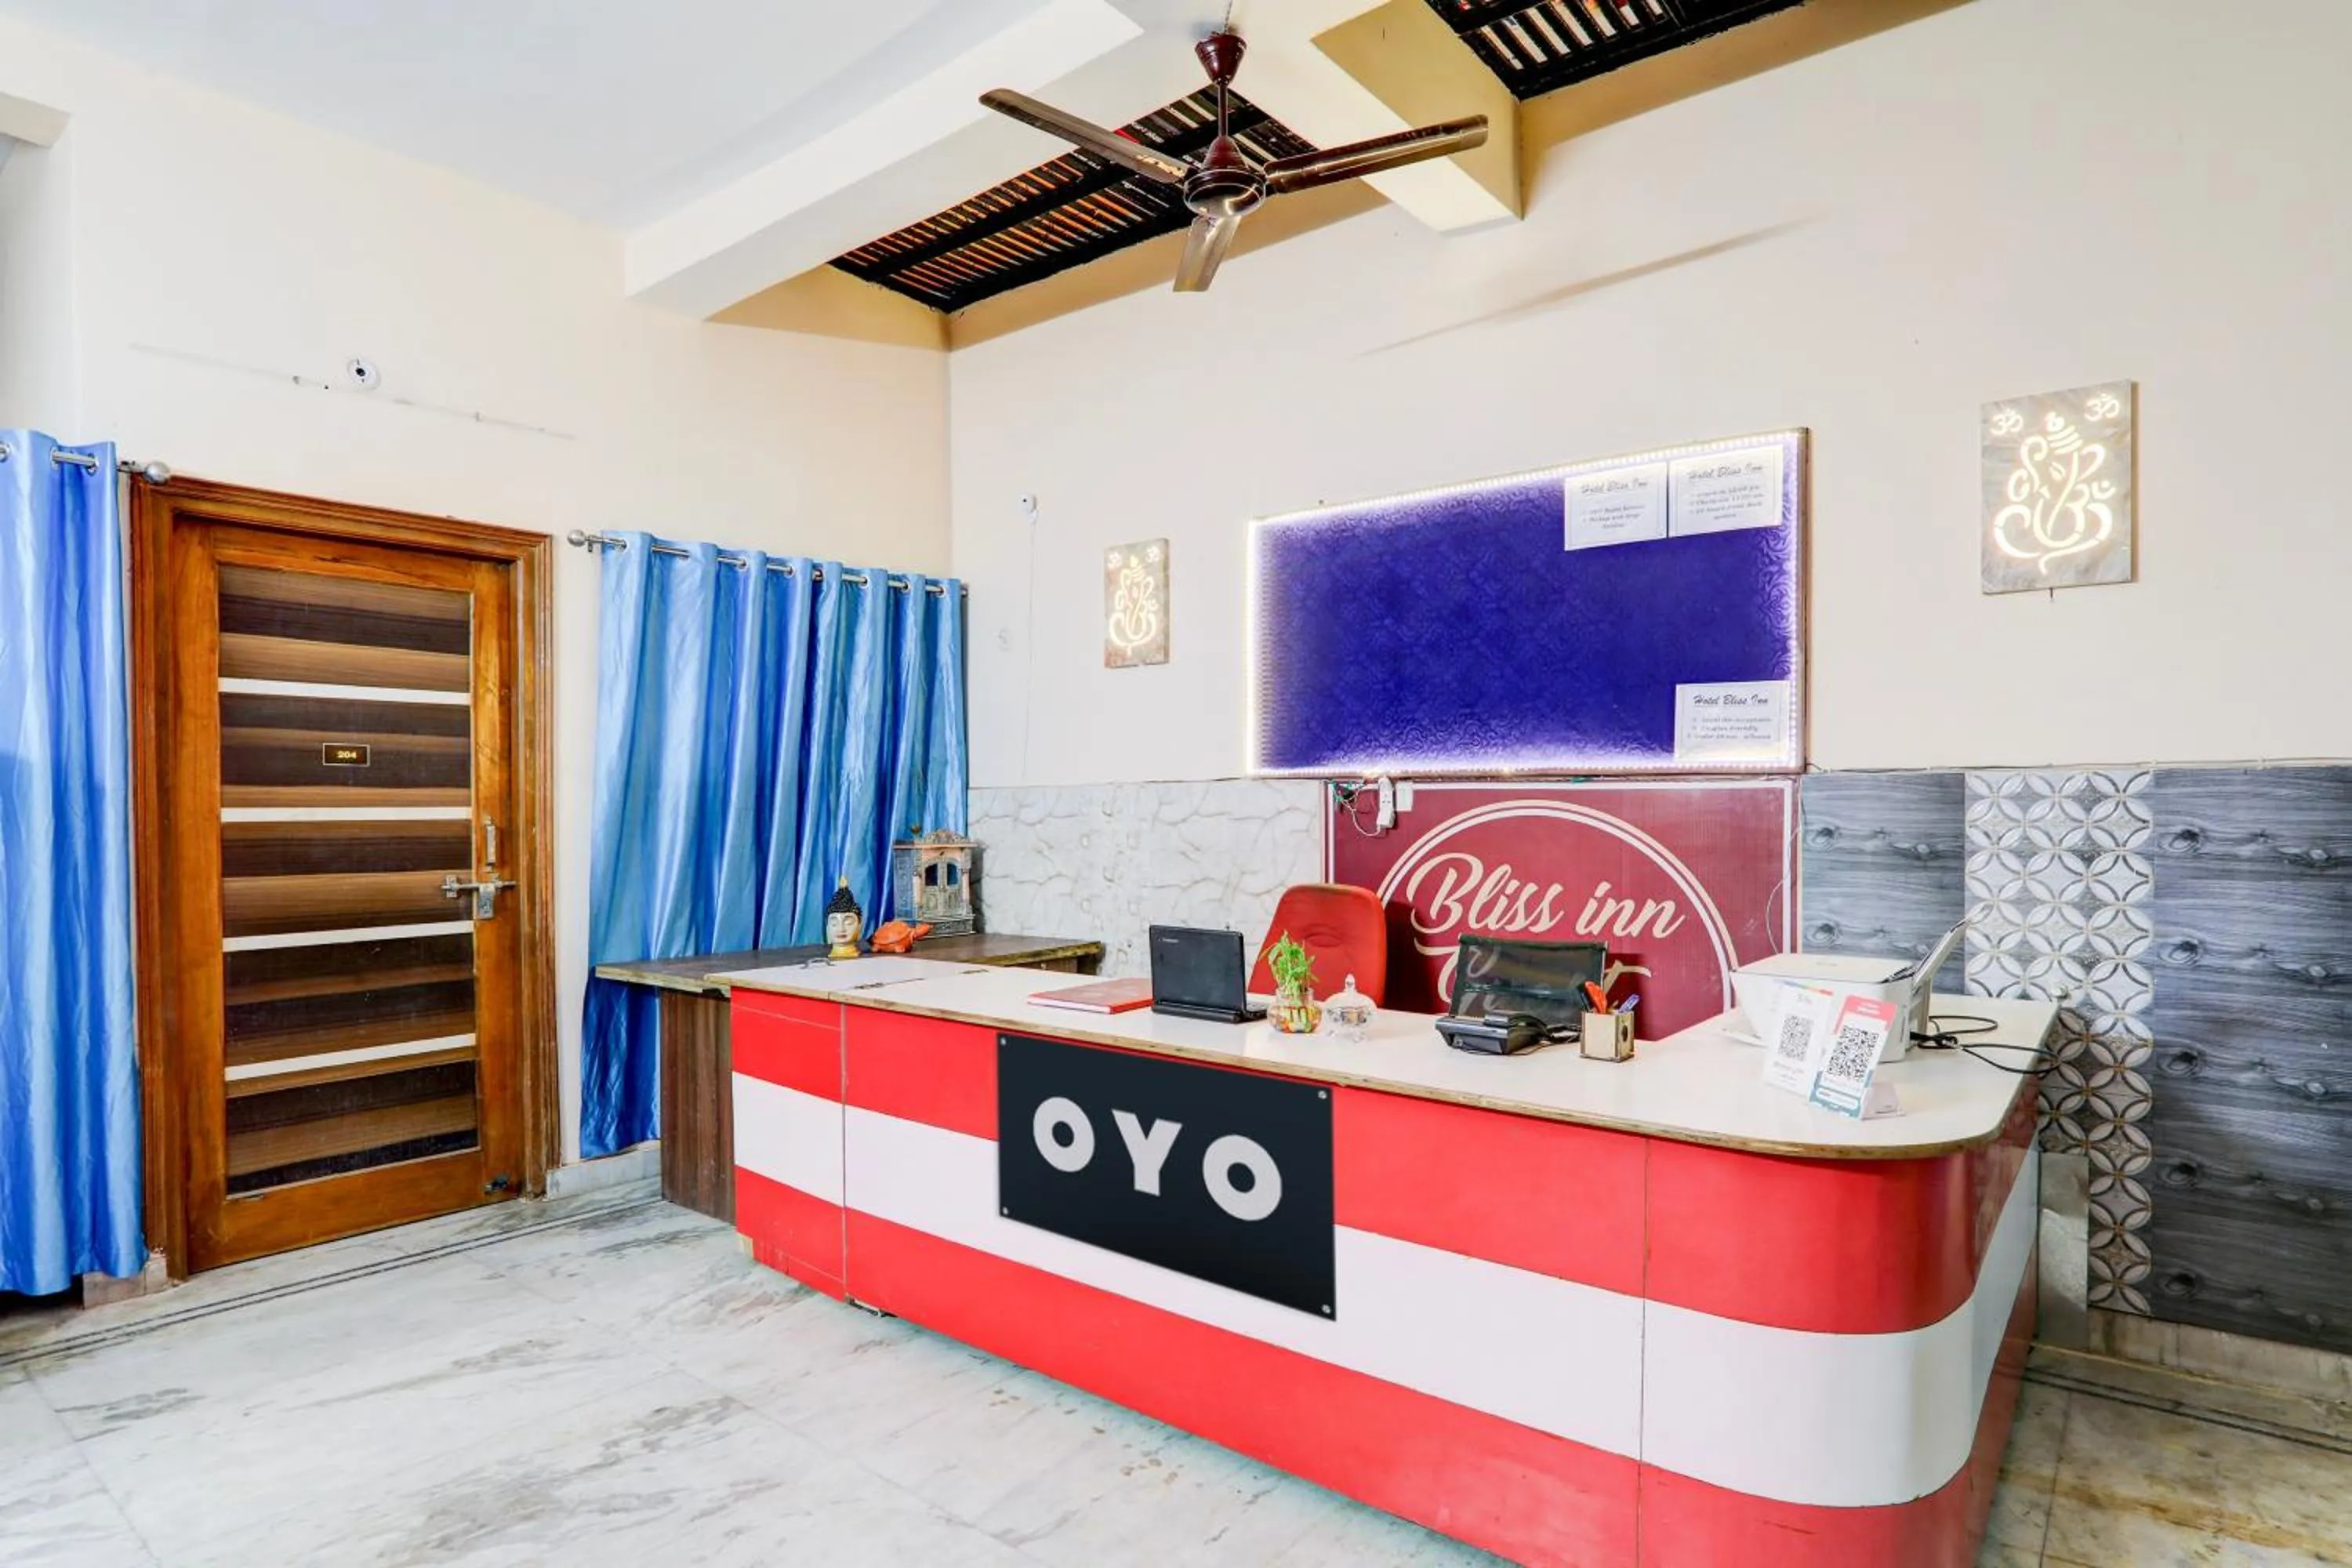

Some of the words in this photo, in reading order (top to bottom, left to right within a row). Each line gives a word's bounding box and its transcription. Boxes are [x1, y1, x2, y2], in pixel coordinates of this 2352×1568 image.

[1693, 694, 1719, 706] Hotel
[1722, 693, 1748, 706] Bliss
[1751, 693, 1769, 706] Inn
[1406, 851, 1565, 935] Bliss
[1574, 880, 1686, 938] inn
[1033, 1096, 1283, 1221] OYO
